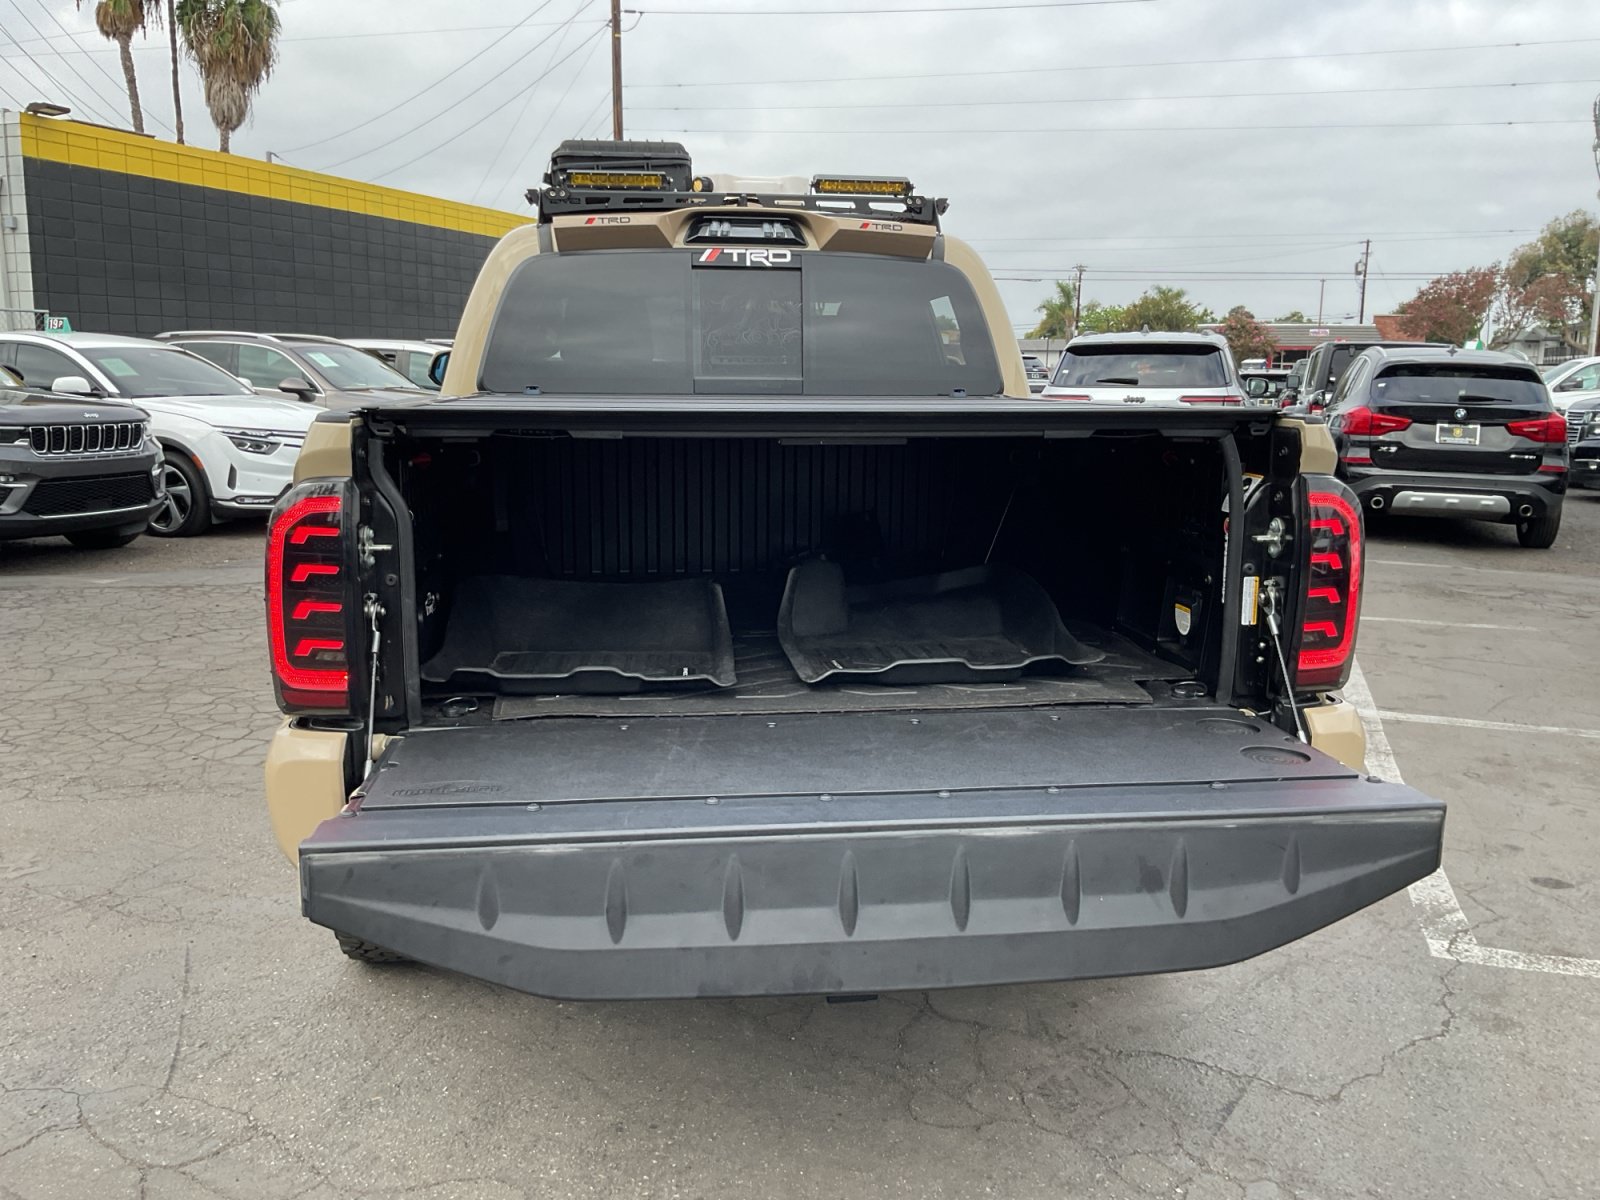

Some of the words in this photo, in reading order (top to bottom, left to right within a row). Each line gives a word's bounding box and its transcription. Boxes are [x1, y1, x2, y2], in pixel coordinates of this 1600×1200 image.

[596, 216, 631, 225] TRD
[871, 222, 903, 232] TRD
[723, 249, 792, 267] TRD
